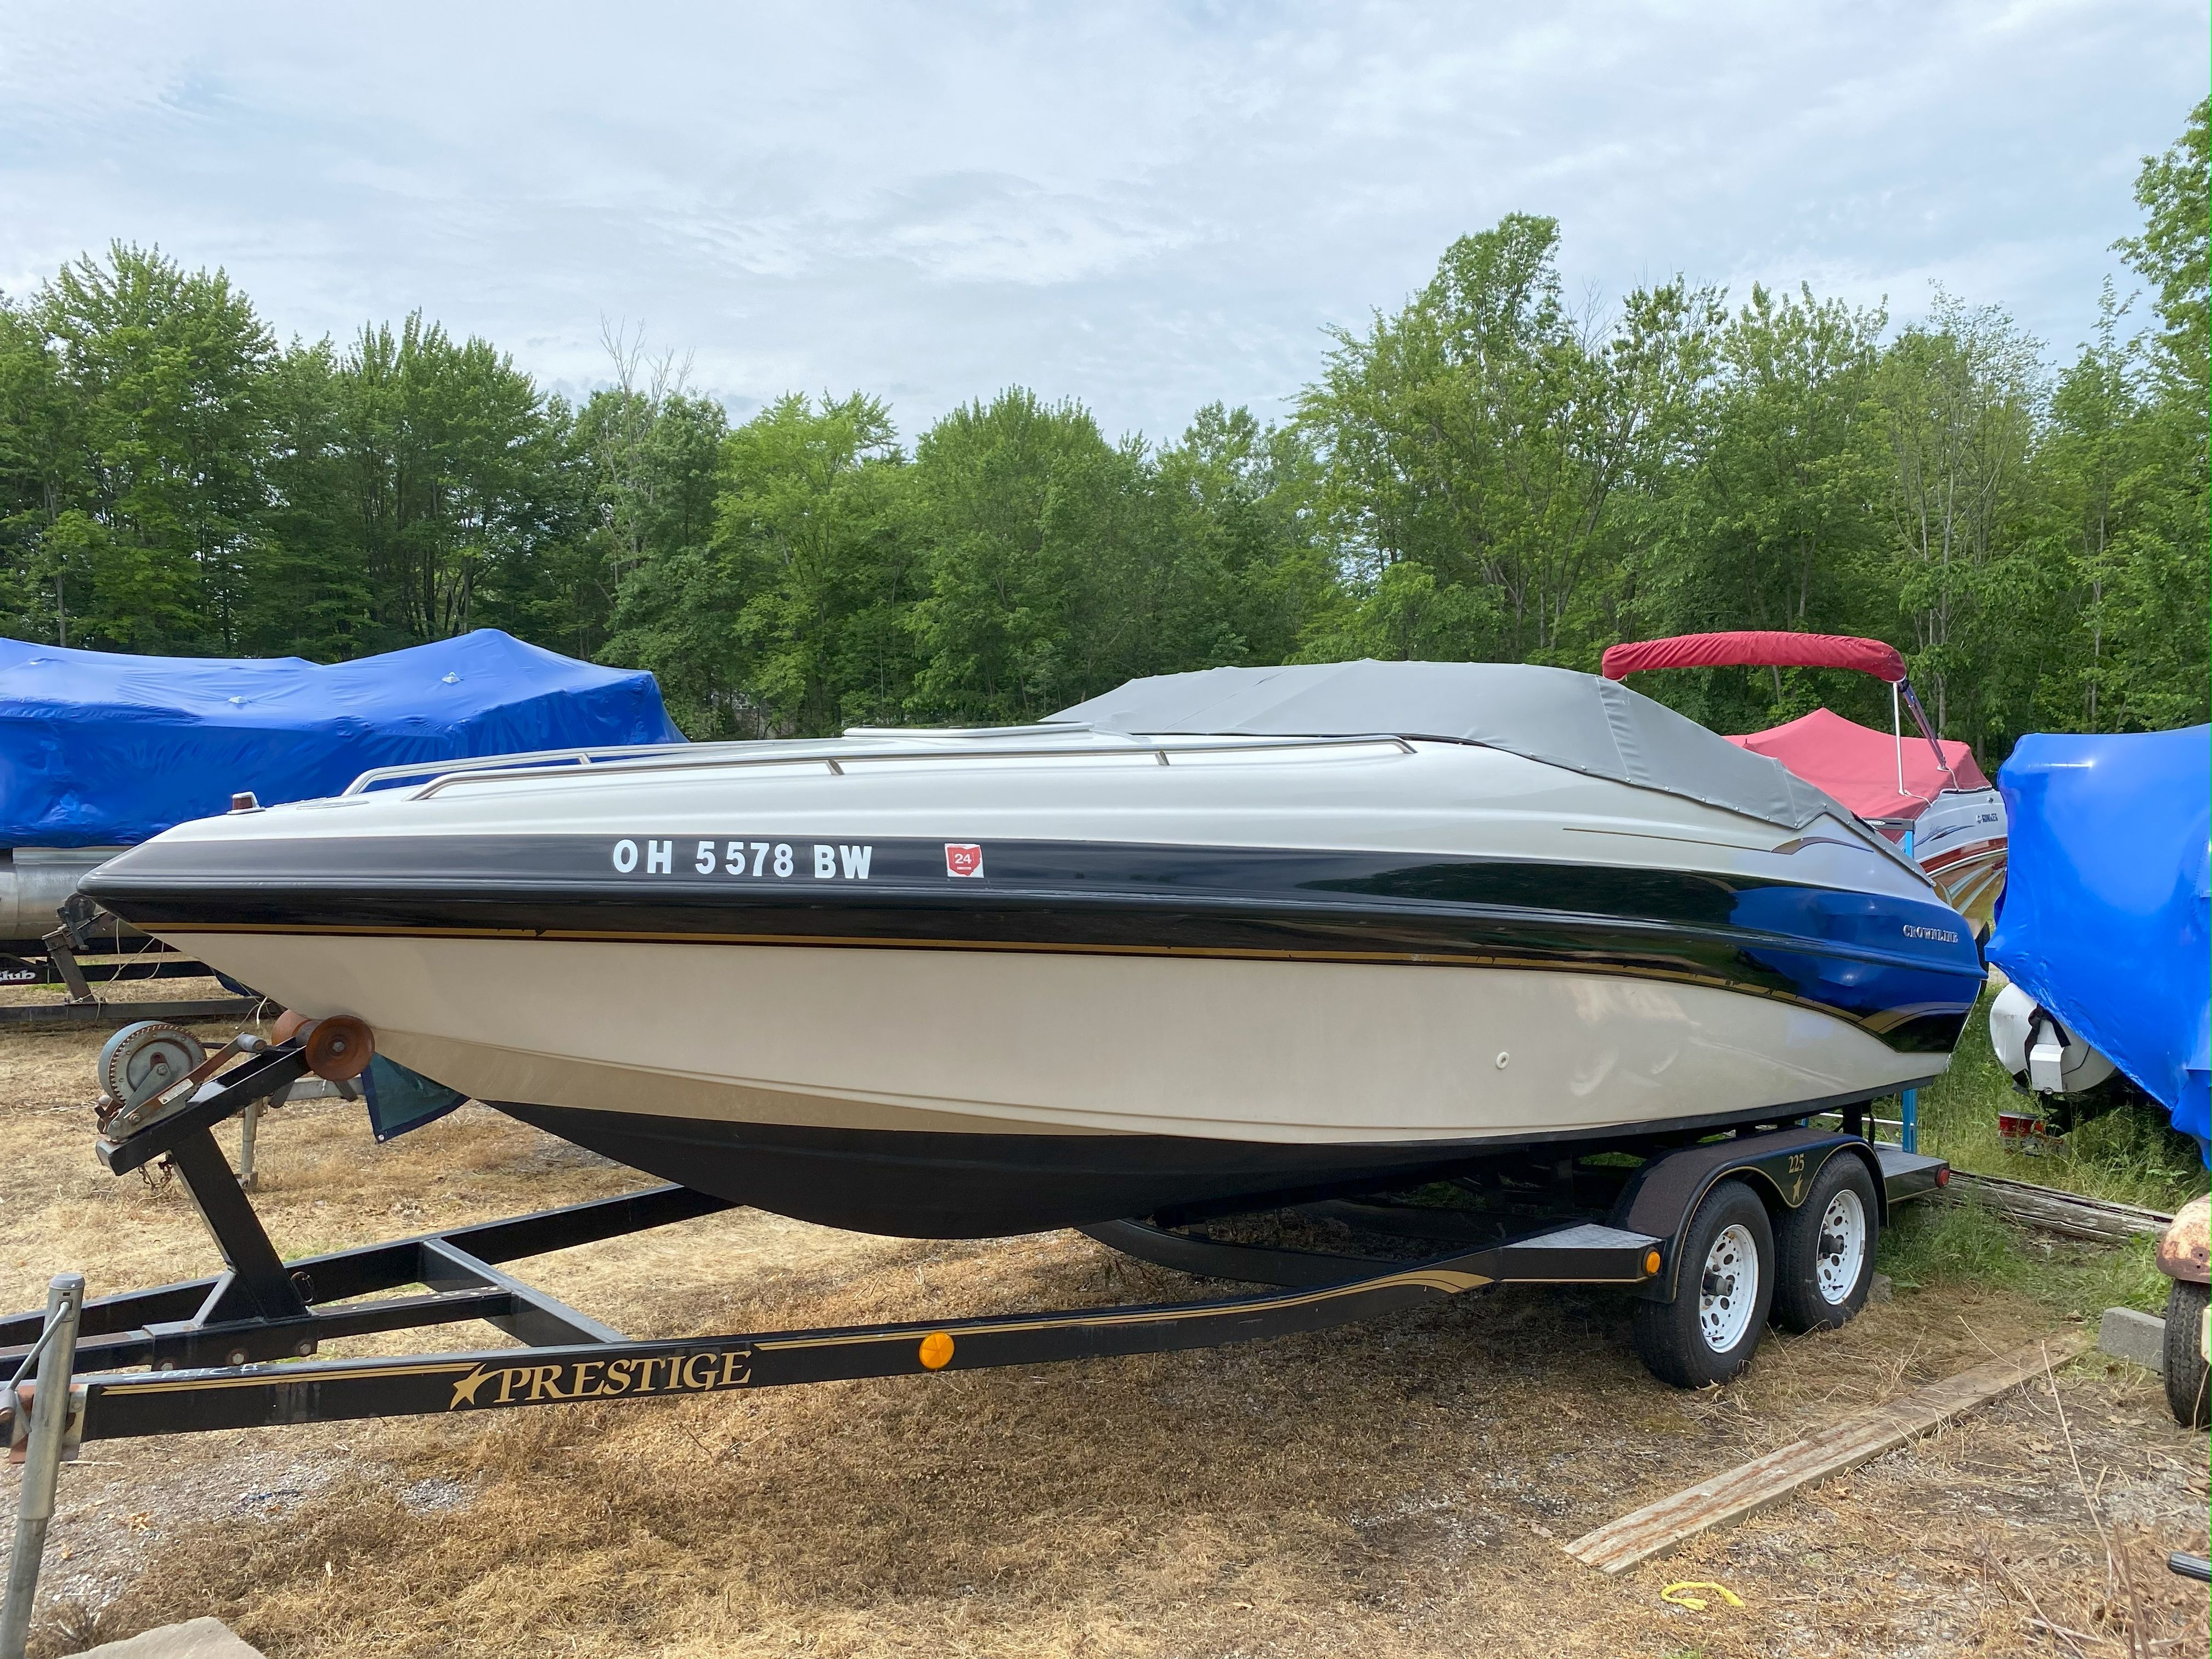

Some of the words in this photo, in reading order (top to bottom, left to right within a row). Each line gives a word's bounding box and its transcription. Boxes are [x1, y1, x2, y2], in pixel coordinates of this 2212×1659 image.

[613, 839, 673, 873] OH
[695, 841, 794, 877] 5578
[814, 844, 872, 879] BW
[955, 853, 972, 864] 24
[1903, 924, 1959, 943] CROWNLINE
[1788, 1153, 1804, 1173] 225
[493, 1350, 752, 1403] PRESTIGE
